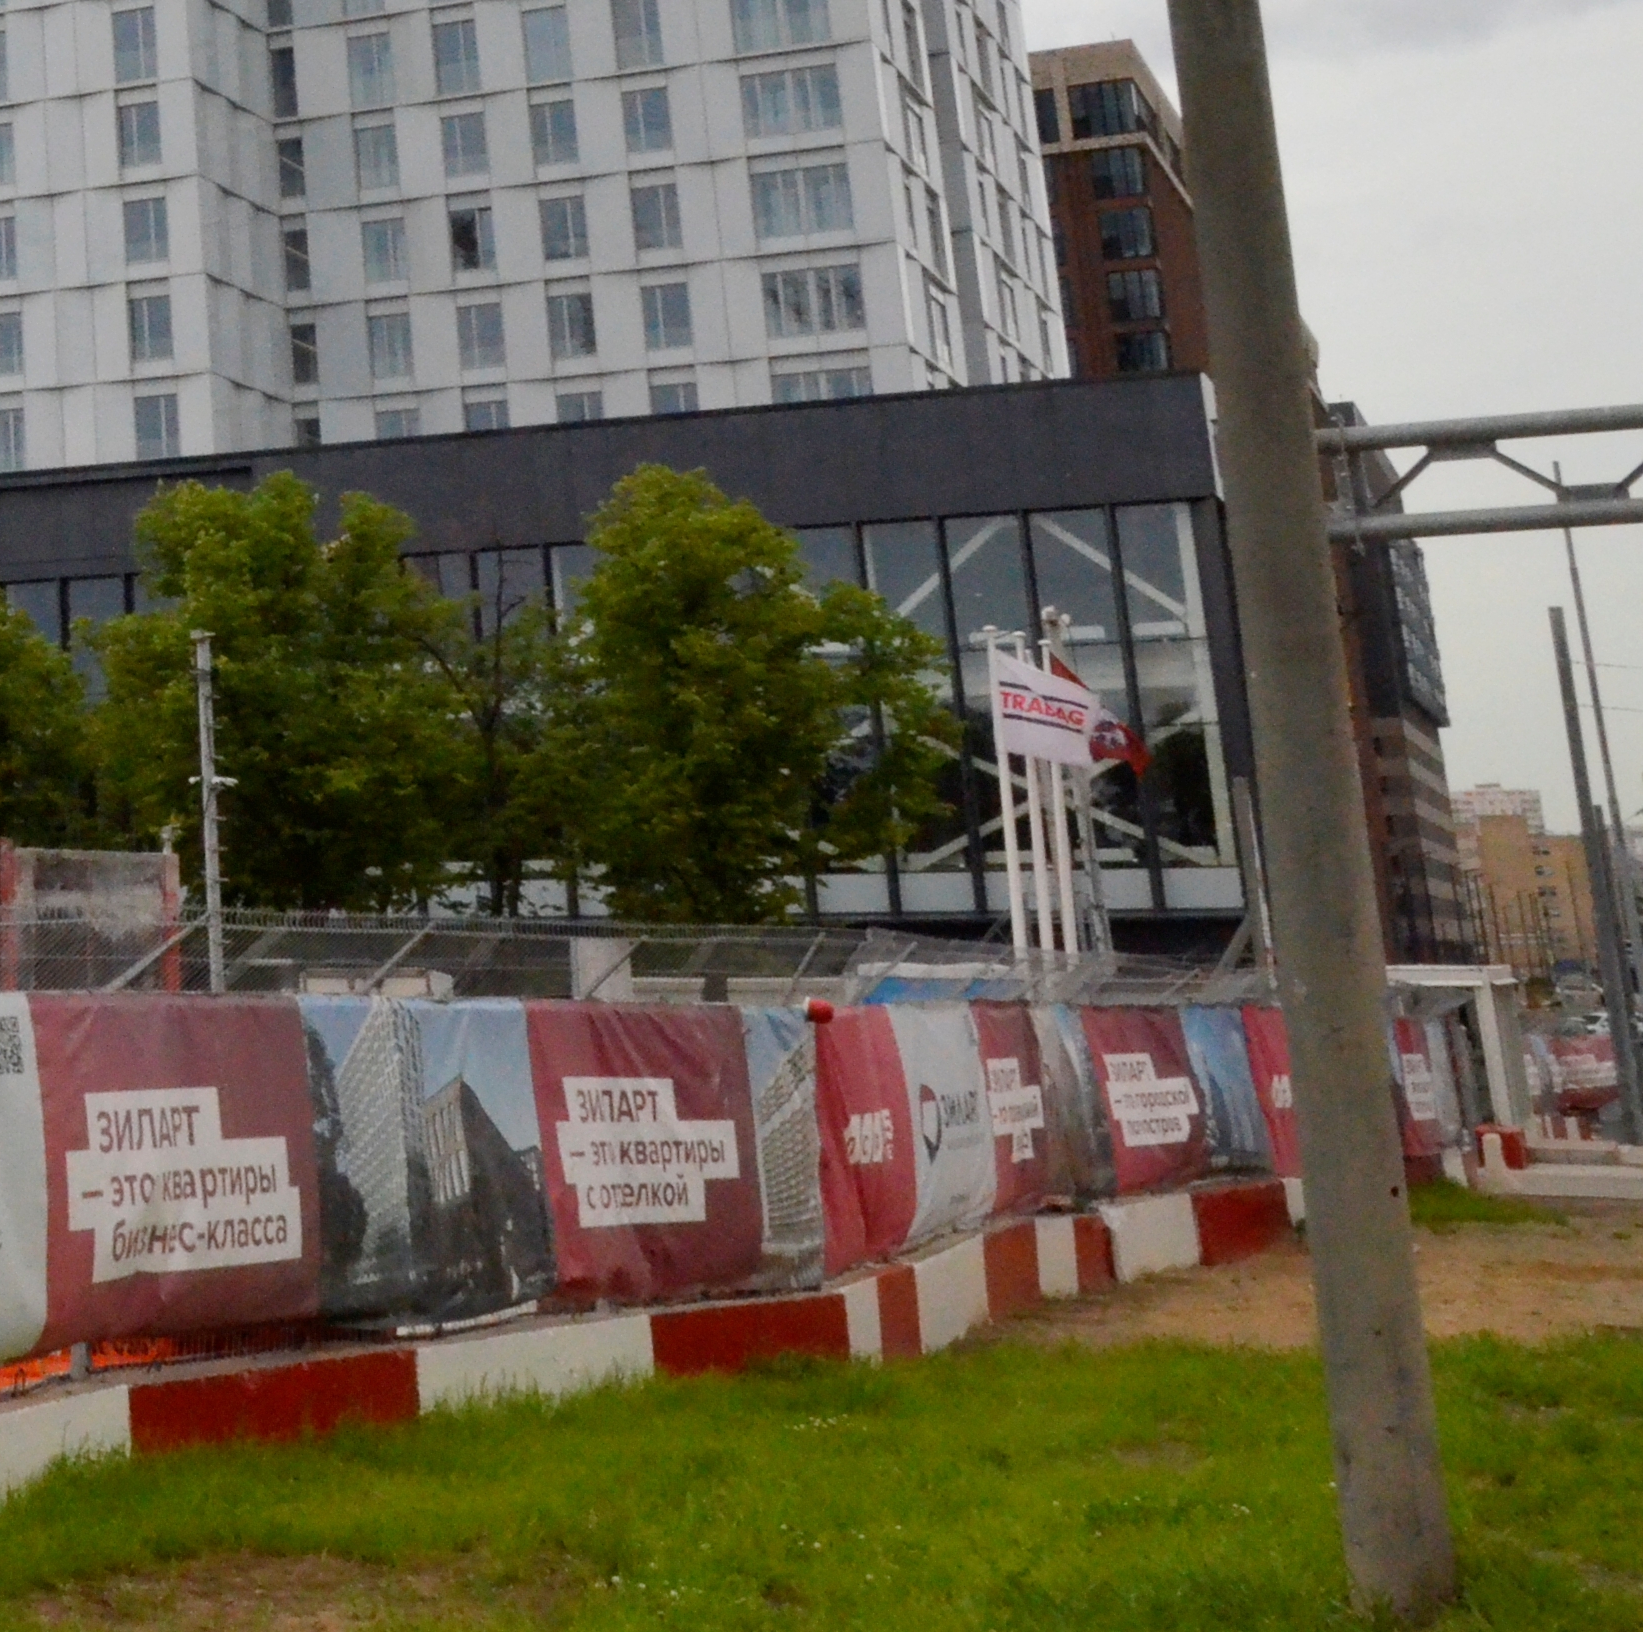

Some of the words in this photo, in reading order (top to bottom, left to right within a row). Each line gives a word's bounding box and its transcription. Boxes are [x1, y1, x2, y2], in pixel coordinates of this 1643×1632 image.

[96, 1105, 200, 1154] ЗИЛАРТ
[619, 1139, 726, 1173] квартиры
[111, 1171, 156, 1207] это
[162, 1164, 277, 1209] квартиры
[586, 1186, 596, 1210] с
[600, 1174, 690, 1209] отелкой
[112, 1214, 289, 1263] бизнес-класса
